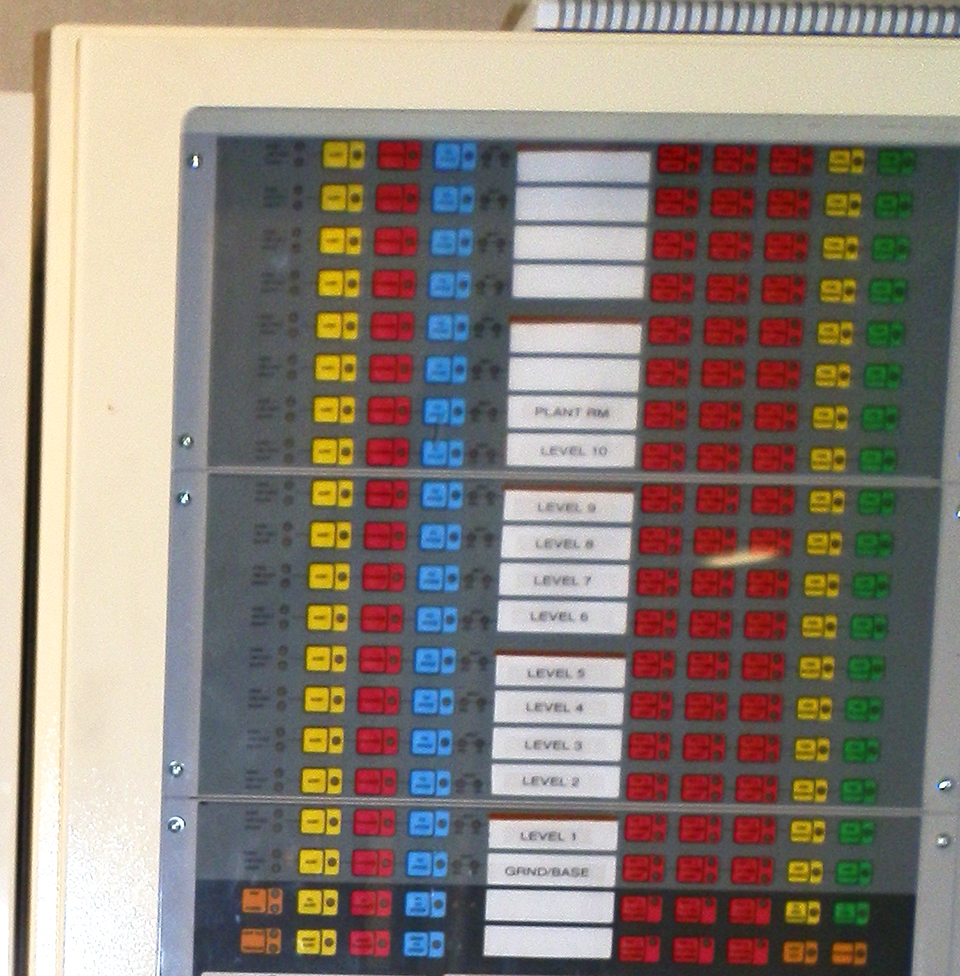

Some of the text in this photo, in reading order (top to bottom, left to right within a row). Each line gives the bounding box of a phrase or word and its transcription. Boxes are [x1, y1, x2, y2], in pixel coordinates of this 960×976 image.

[534, 406, 610, 418] PLANT RM
[540, 446, 608, 457] LEVEL 10
[537, 502, 582, 513] LEVEL
[535, 538, 580, 549] LEVEL
[533, 575, 592, 586] LEVEL 7
[530, 611, 589, 622] LEVEL 6
[527, 668, 586, 679] LEVEL 5
[526, 702, 584, 713] LEVEL 4
[524, 740, 583, 751] LEVEL 3
[522, 776, 580, 787] LEVEL 2
[520, 831, 565, 842] LEVEL
[504, 865, 590, 878] GRND/BASE
